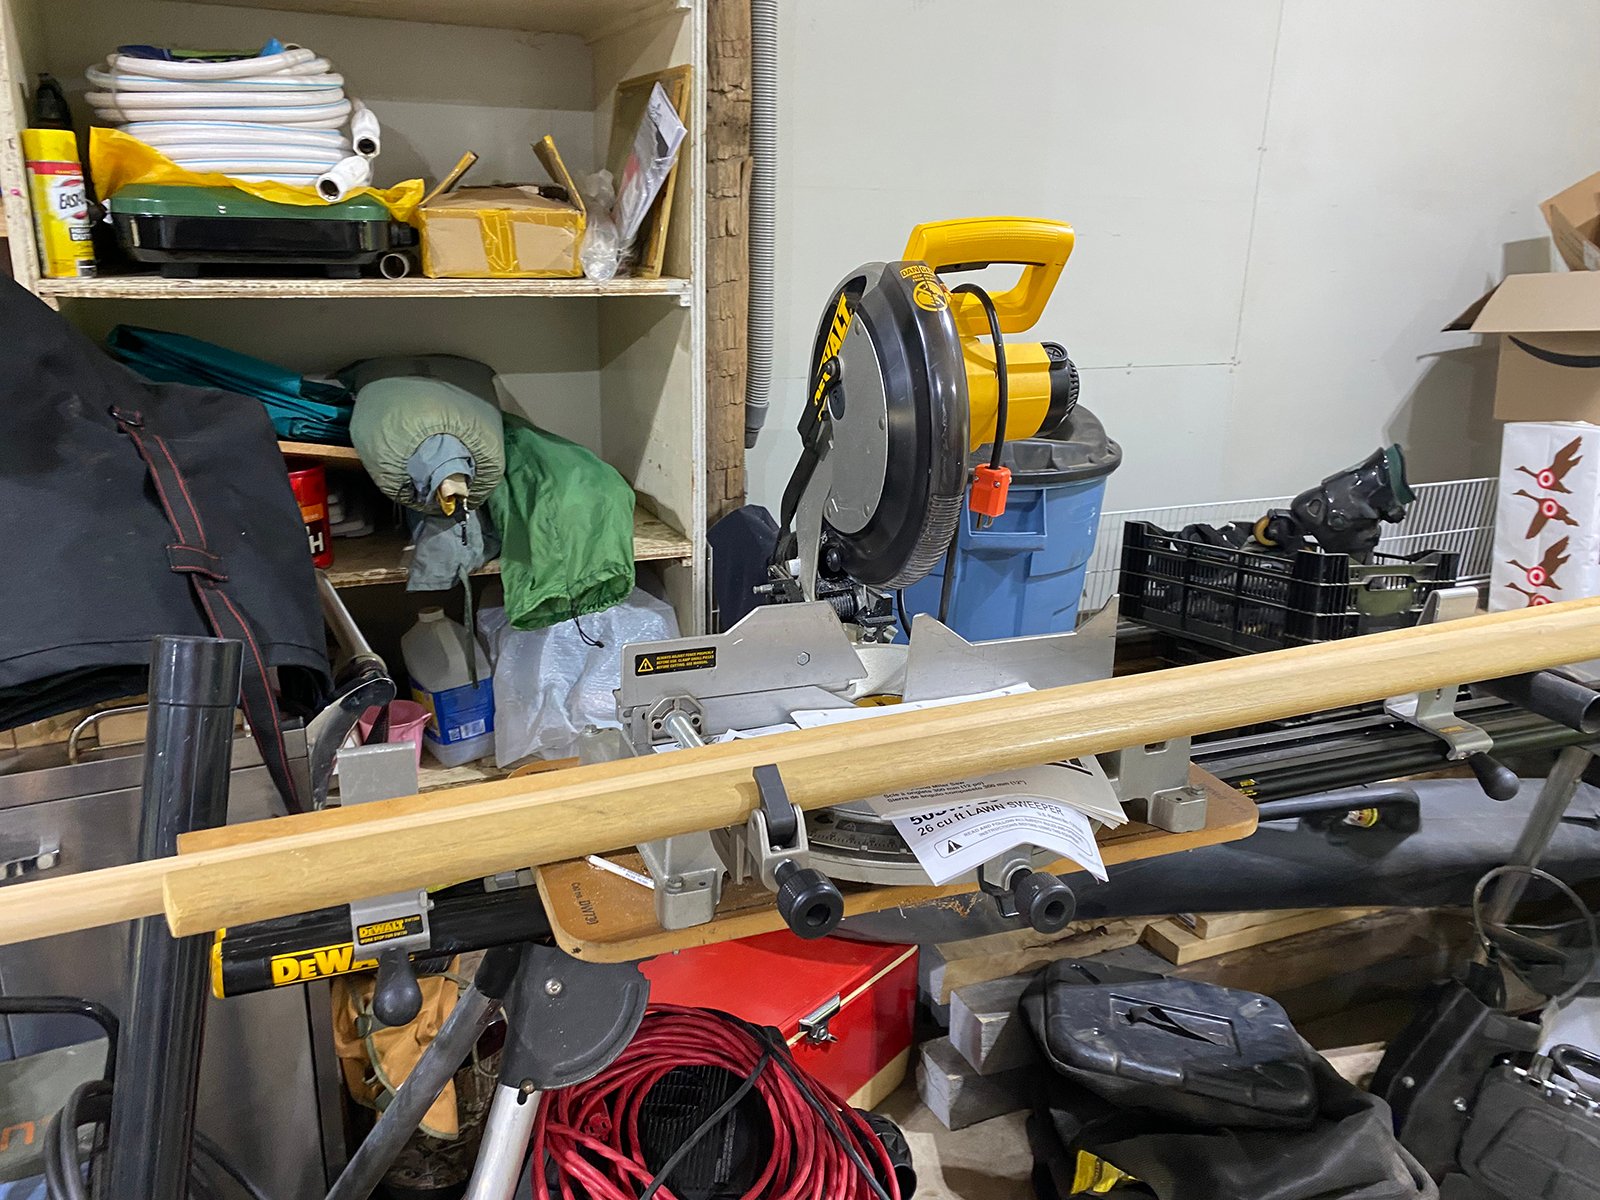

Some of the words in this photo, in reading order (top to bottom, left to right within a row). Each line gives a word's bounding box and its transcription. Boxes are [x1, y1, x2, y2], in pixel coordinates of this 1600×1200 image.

[305, 525, 325, 555] H
[917, 825, 934, 836] 26
[936, 818, 953, 828] cu
[954, 812, 966, 821] ft
[965, 803, 1005, 817] LAWN
[1006, 800, 1063, 816] SWEEPER
[963, 829, 979, 838] READ
[979, 824, 992, 833] AND
[992, 818, 1015, 827] FOLLOW
[978, 822, 1017, 838] INSTRUCTIONS
[358, 919, 406, 938] DEWALT
[272, 946, 379, 985] DEW
